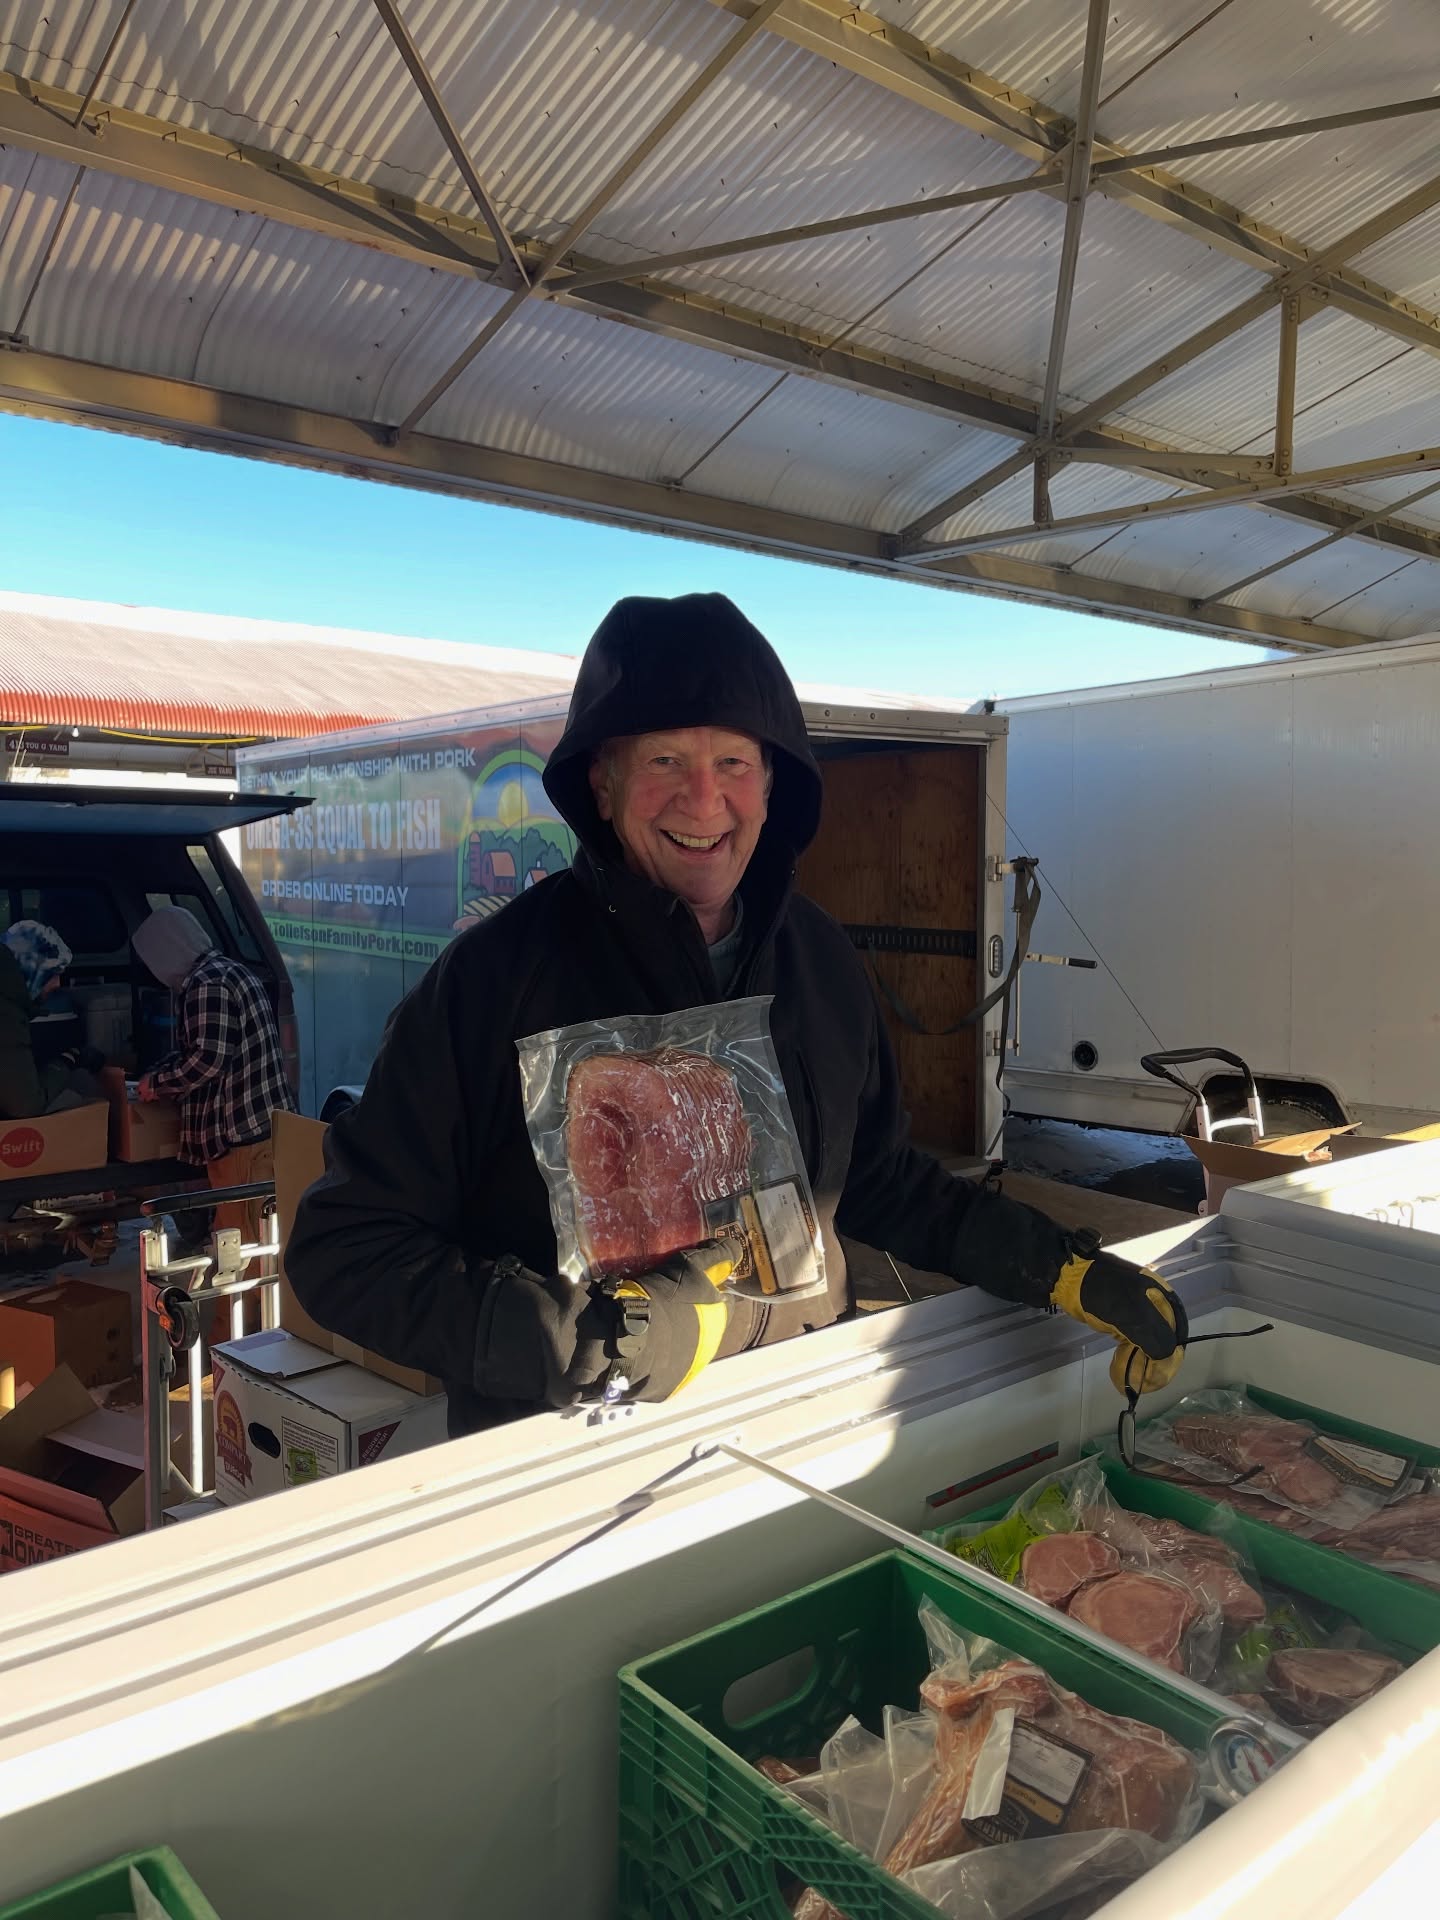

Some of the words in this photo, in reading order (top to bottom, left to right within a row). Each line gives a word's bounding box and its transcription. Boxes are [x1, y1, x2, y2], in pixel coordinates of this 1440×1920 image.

[49, 743, 68, 751] YANG
[241, 771, 277, 789] RETHINK
[280, 767, 308, 784] YOUR
[311, 758, 393, 782] RELATIONSHIP
[396, 752, 430, 773] WITH
[434, 747, 476, 769] PORK
[246, 806, 314, 850] OMEGA-3s
[317, 803, 366, 855] EQUAL
[368, 801, 392, 850] TO
[396, 799, 440, 850] FISH
[261, 879, 301, 899] ORDER
[303, 881, 353, 903] ONLINE
[353, 884, 409, 907] TODAY
[270, 921, 440, 958] TollefsonFamilyPork.com
[2, 1138, 42, 1155] Swift
[14, 1524, 81, 1556] GREATE
